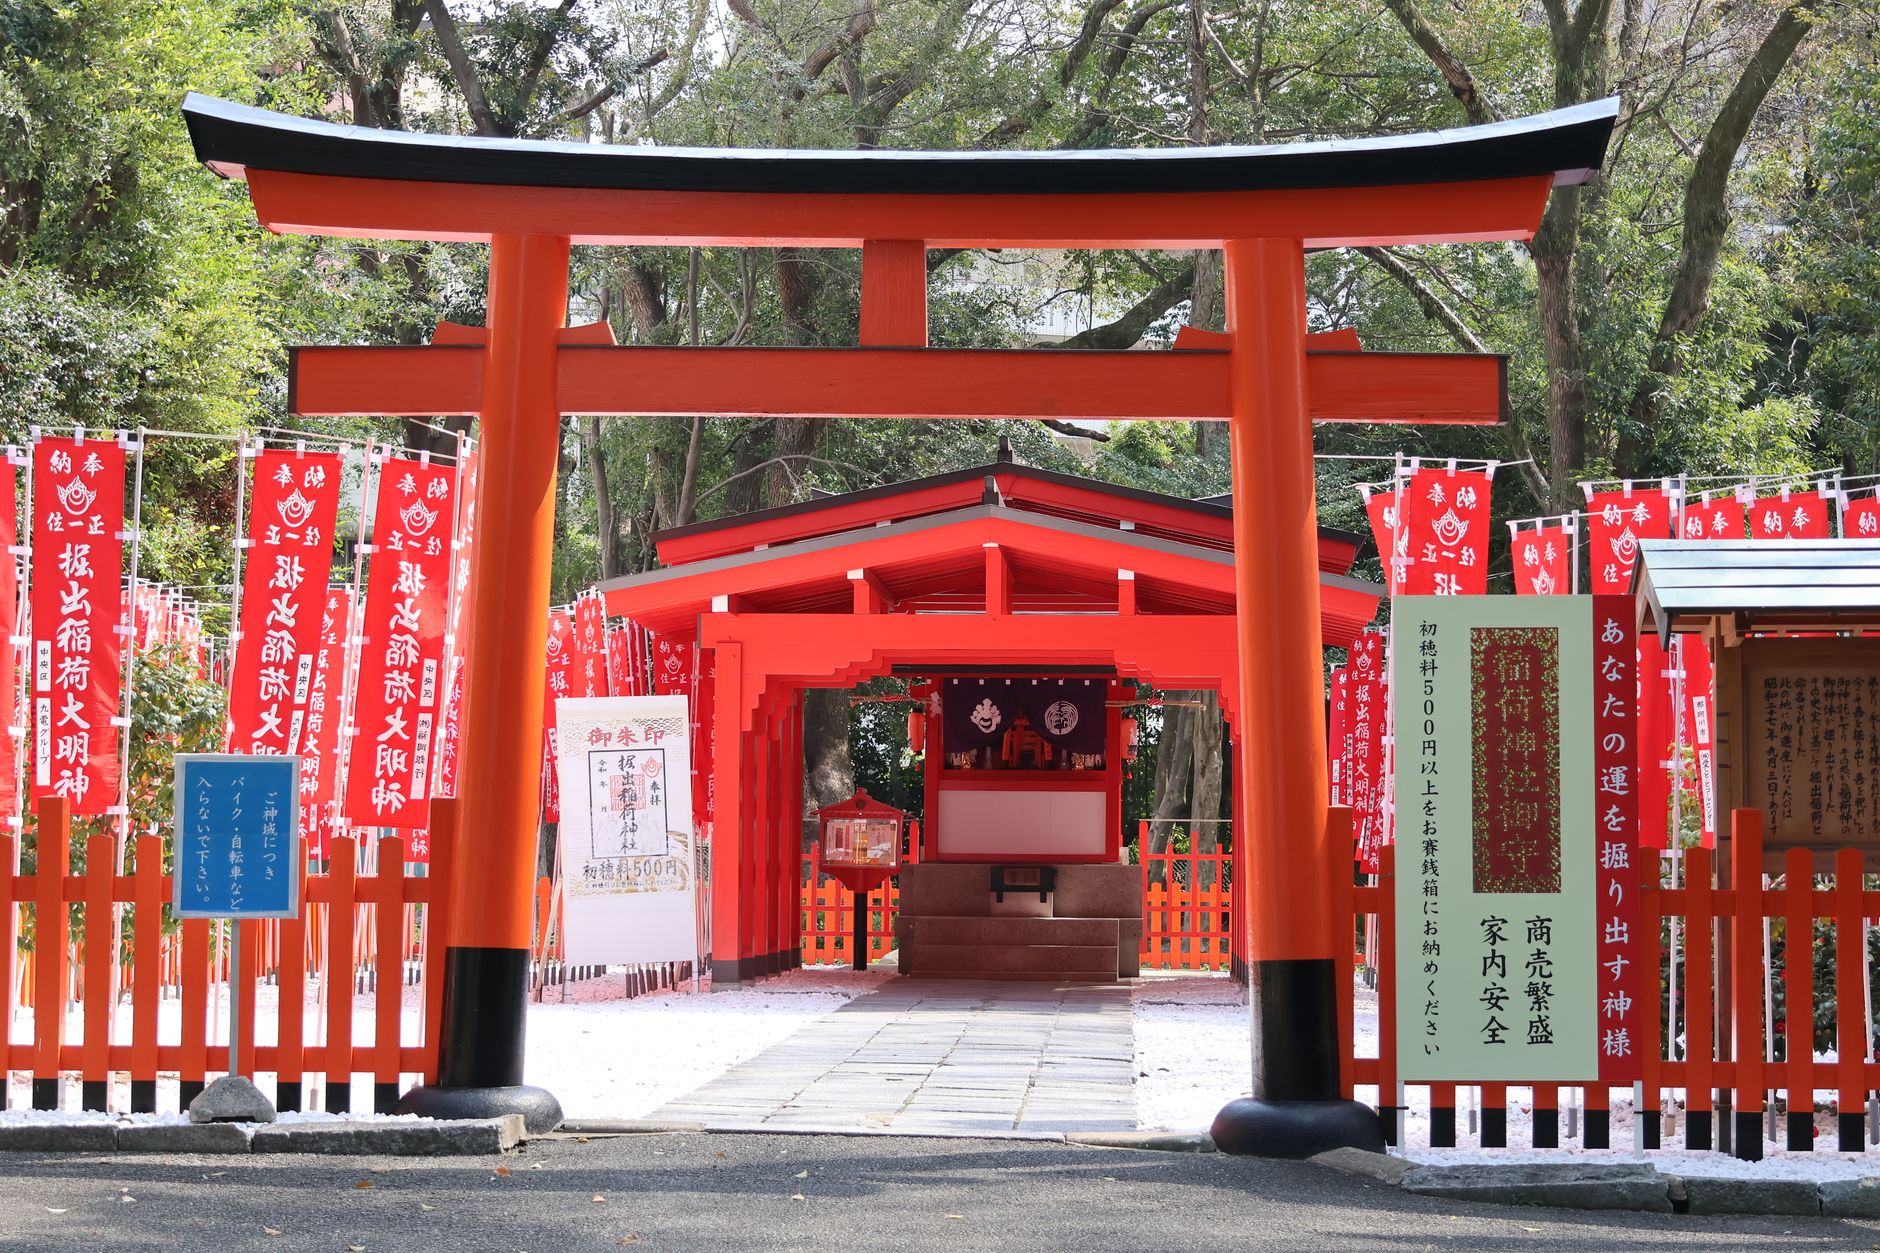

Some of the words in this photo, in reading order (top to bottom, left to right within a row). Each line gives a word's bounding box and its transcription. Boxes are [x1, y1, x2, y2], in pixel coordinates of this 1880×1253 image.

[49, 449, 105, 478] 奉納
[46, 511, 105, 535] 正一位
[1522, 540, 1557, 567] 奉納
[1686, 509, 1730, 540] 奉納
[1762, 505, 1811, 534] 奉納
[39, 647, 50, 681] 中央区
[53, 542, 95, 806] 掘出稲荷大明神
[38, 702, 51, 765] 九電グループ
[587, 727, 665, 747] 御朱印
[195, 776, 213, 903] 入らないで下さい。
[228, 776, 245, 910] バイク・自転車など
[262, 791, 279, 881] ご神域につき
[618, 754, 640, 855] 掘出稲荷神社
[1418, 619, 1440, 1056] 初穂料500円以上をお賽銭箱にお納めください
[1599, 617, 1632, 1058] あなたの運を掘り出す神様
[1479, 914, 1510, 1045] 家内安全
[1523, 914, 1555, 1045] 商売繁盛
